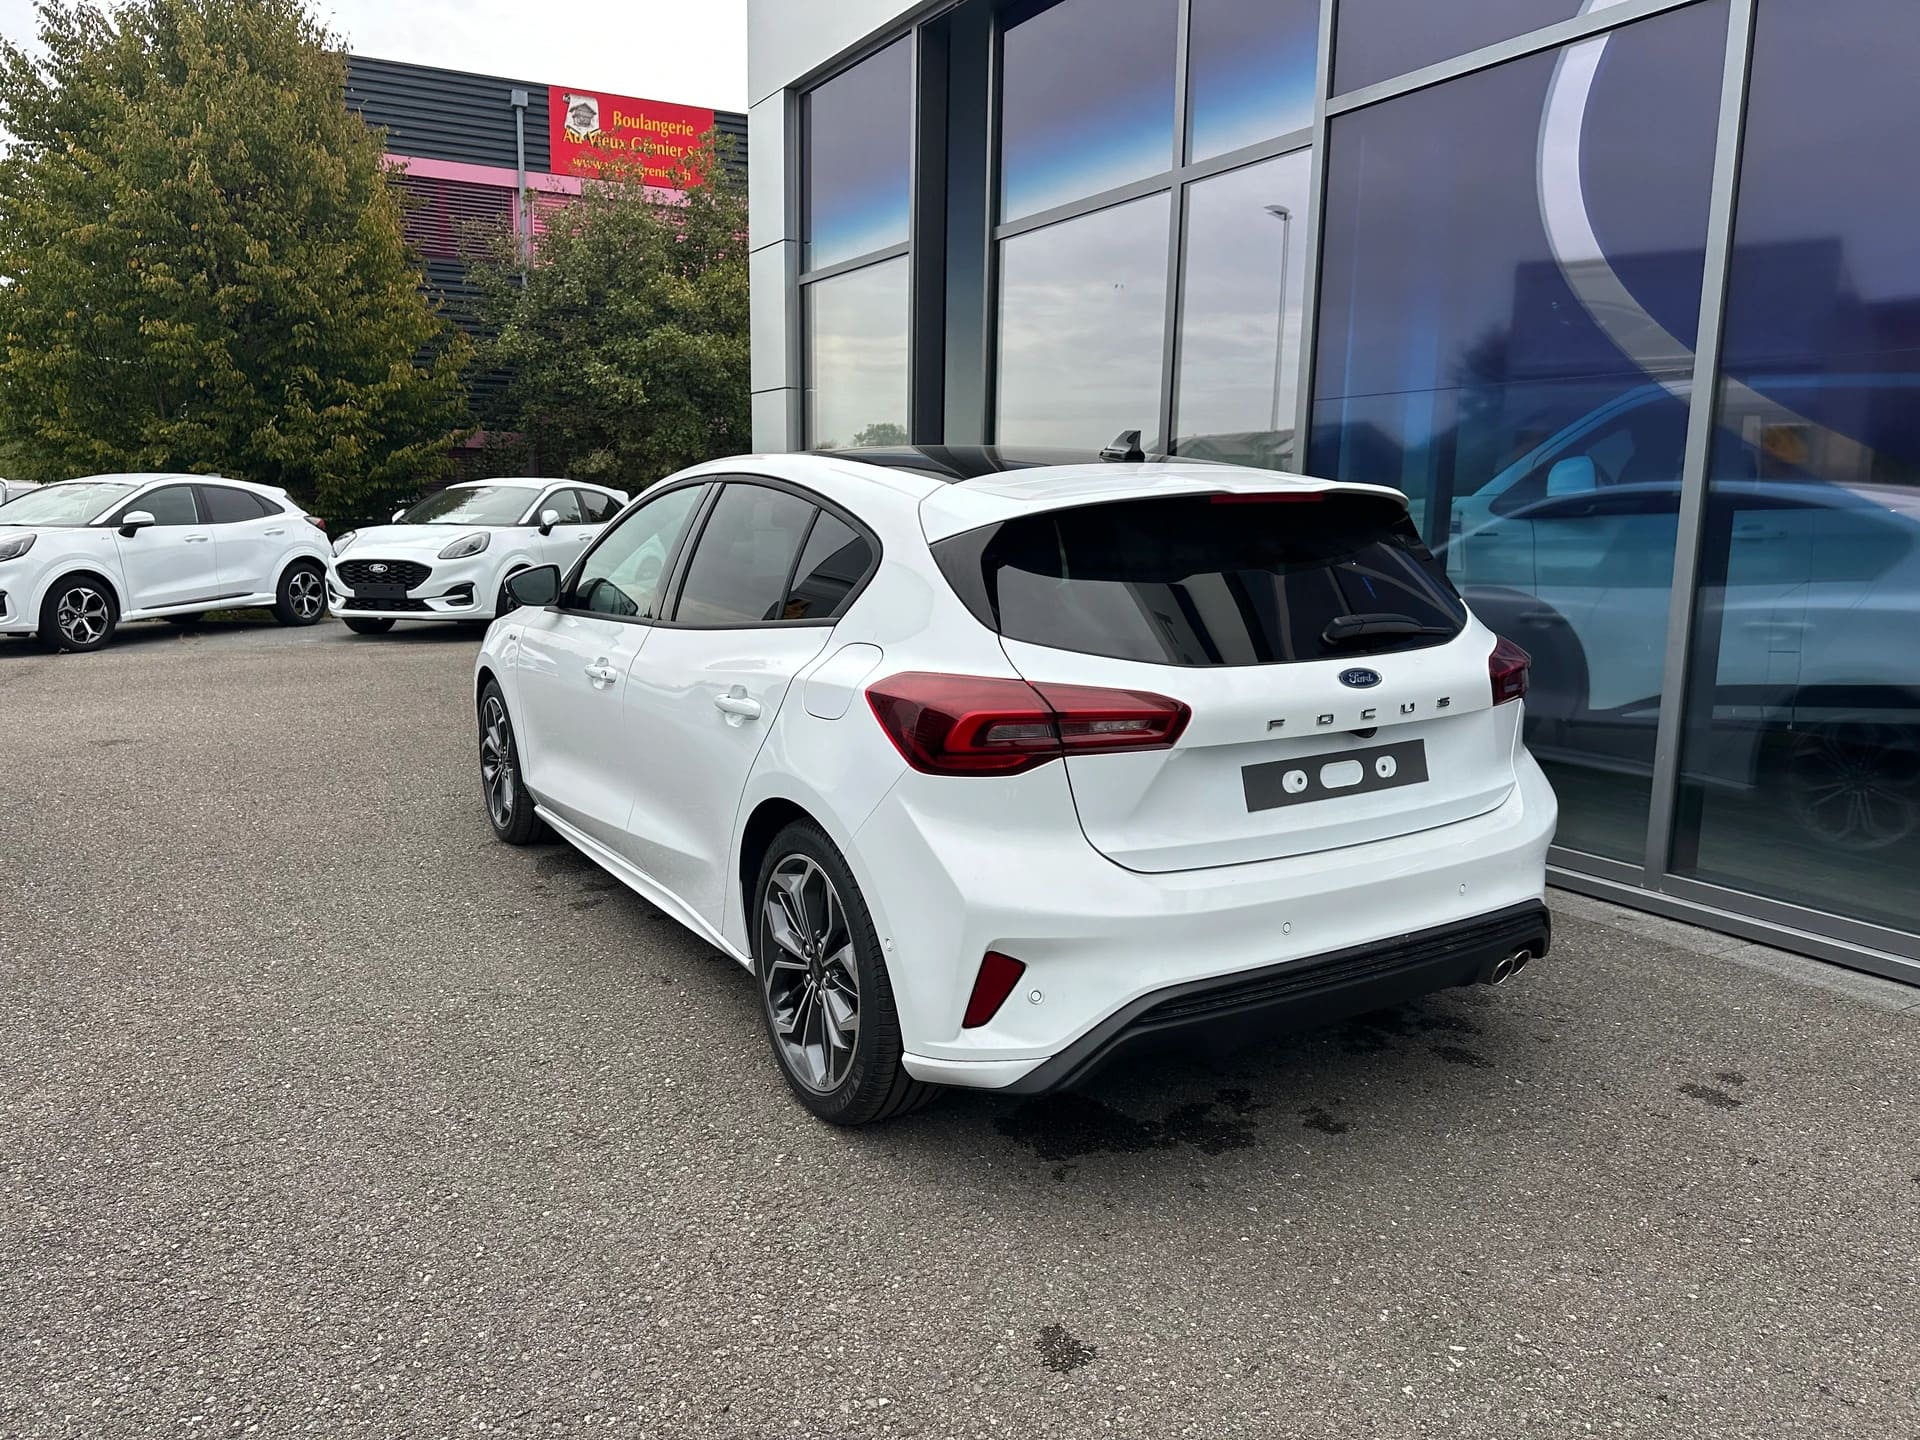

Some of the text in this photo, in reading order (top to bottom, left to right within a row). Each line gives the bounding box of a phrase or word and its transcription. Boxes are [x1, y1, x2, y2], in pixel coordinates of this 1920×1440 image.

[613, 110, 694, 137] Boulangerie
[563, 128, 583, 145] Au
[630, 136, 684, 157] Grenier
[1266, 696, 1450, 731] FOCUS
